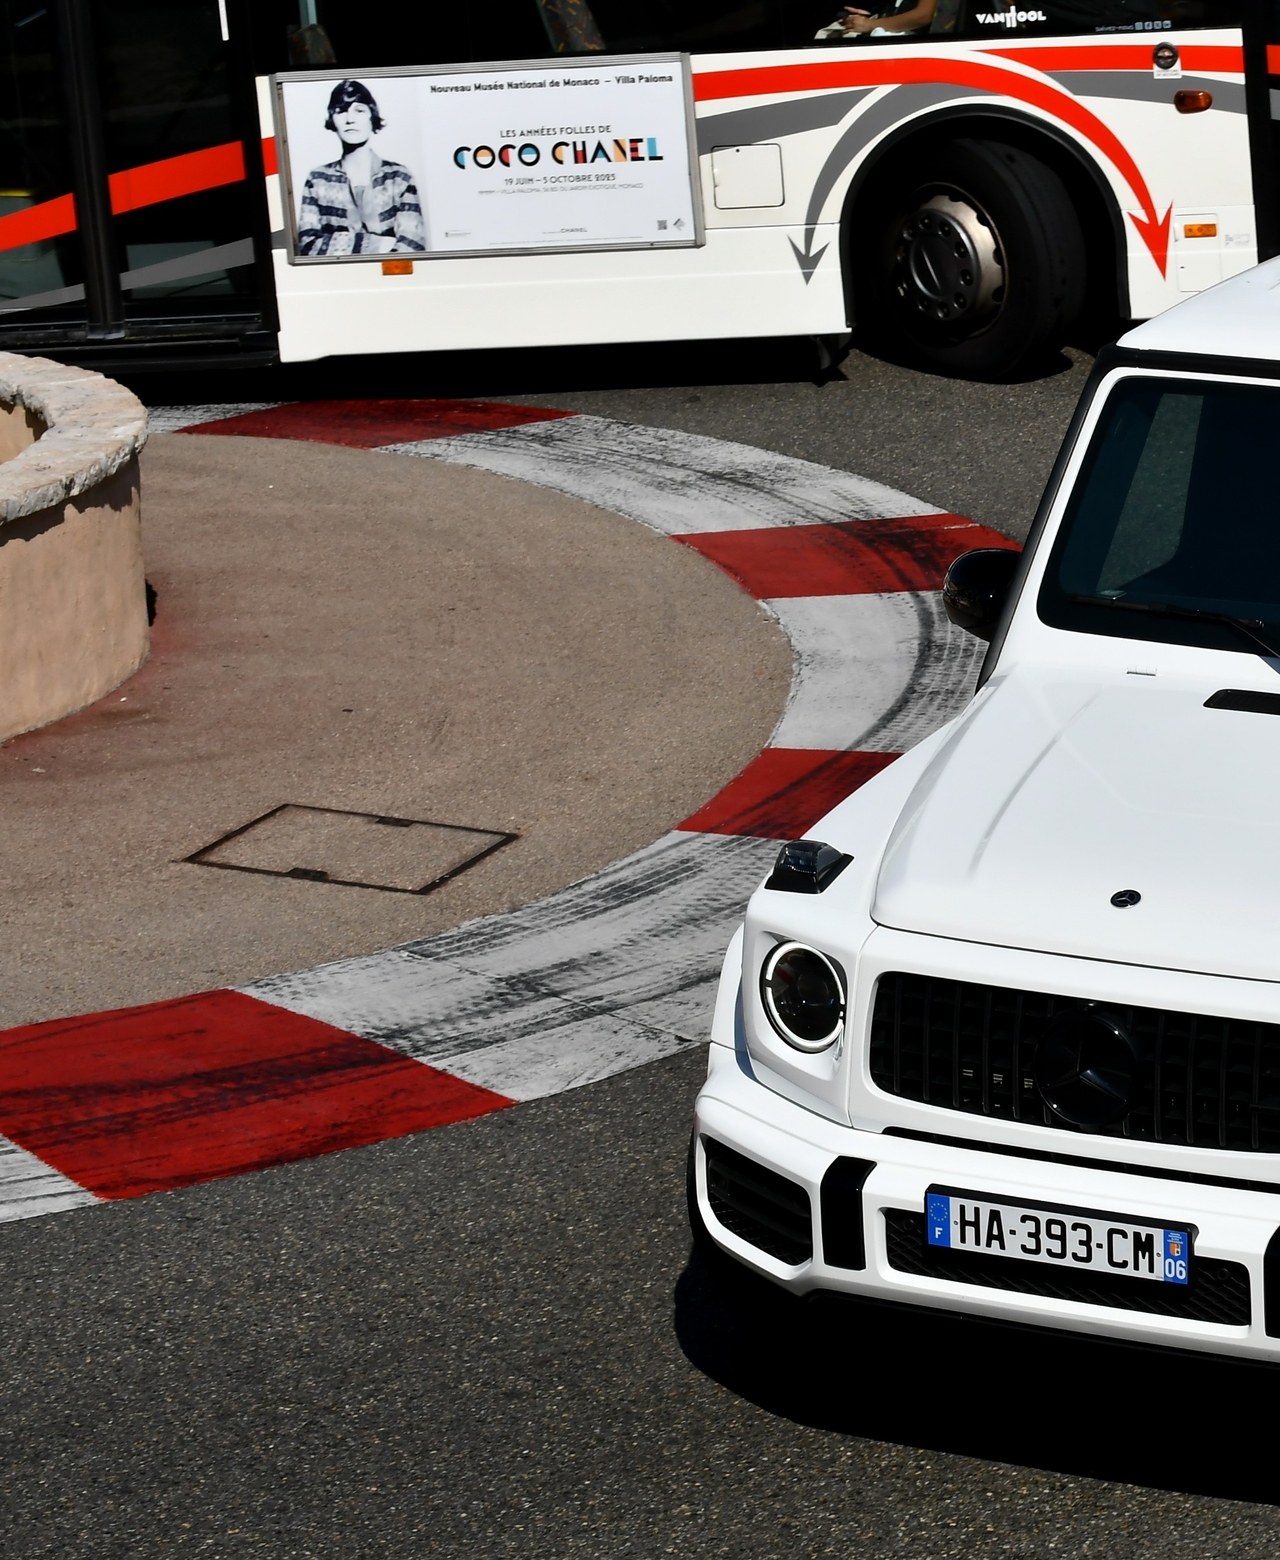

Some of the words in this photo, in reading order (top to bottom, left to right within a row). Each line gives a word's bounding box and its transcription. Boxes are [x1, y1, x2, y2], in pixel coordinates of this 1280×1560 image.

[430, 85, 471, 93] Nouveau
[474, 81, 505, 91] Musée
[507, 80, 546, 90] National
[549, 79, 560, 88] de
[563, 78, 600, 87] Monaco
[615, 76, 636, 84] Villa
[638, 75, 673, 83] Paloma
[500, 130, 516, 138] LES
[519, 126, 557, 137] ANNÉES
[560, 126, 596, 135] FOLLES
[598, 125, 612, 133] DE
[453, 143, 541, 170] COCO
[551, 137, 664, 165] CHANEL
[504, 178, 513, 186] 19
[515, 177, 534, 185] JUIN
[543, 176, 548, 184] 5
[549, 174, 592, 184] OCTOBRE
[595, 173, 616, 182] 2025
[934, 1227, 943, 1238] F
[959, 1204, 1155, 1273] HA-393-CM
[1165, 1258, 1186, 1280] 06
